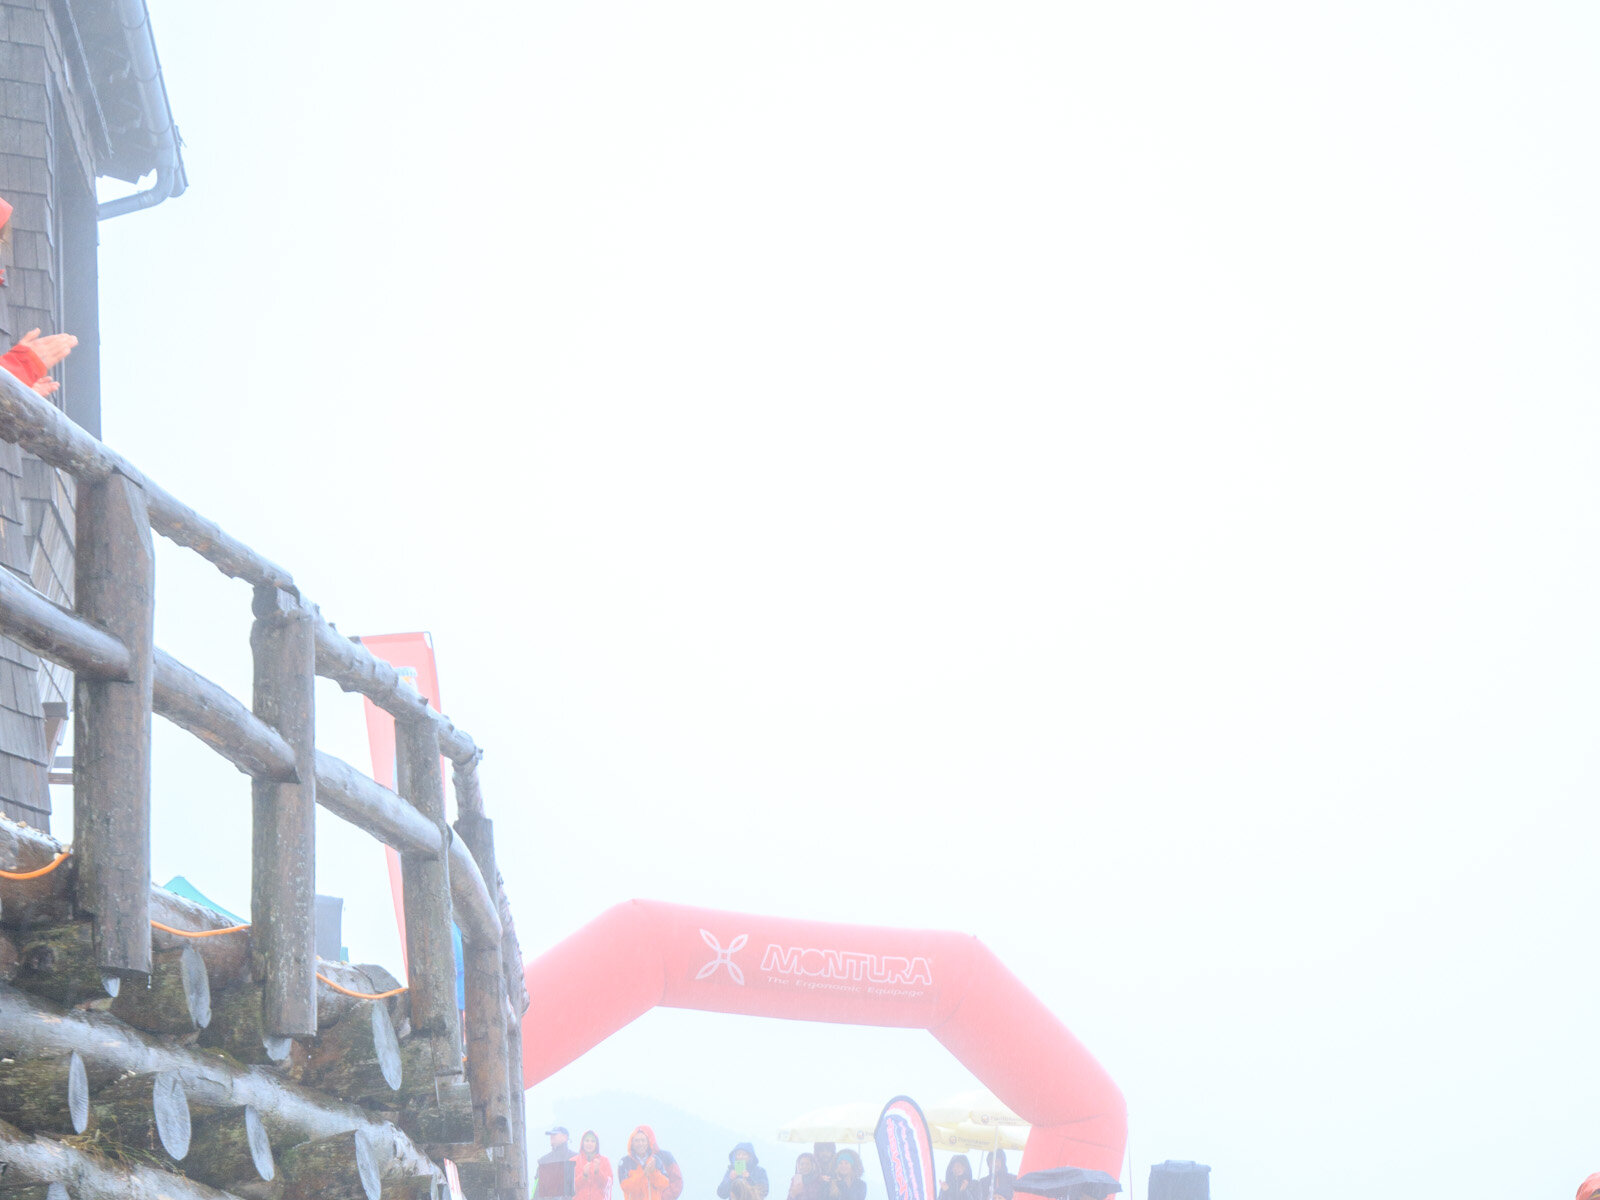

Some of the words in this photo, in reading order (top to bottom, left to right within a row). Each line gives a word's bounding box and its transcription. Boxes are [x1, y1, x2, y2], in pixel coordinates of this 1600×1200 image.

[760, 943, 932, 986] MONTURA
[767, 975, 790, 986] The
[795, 979, 862, 993] Ergonomic
[867, 986, 924, 998] Equipage
